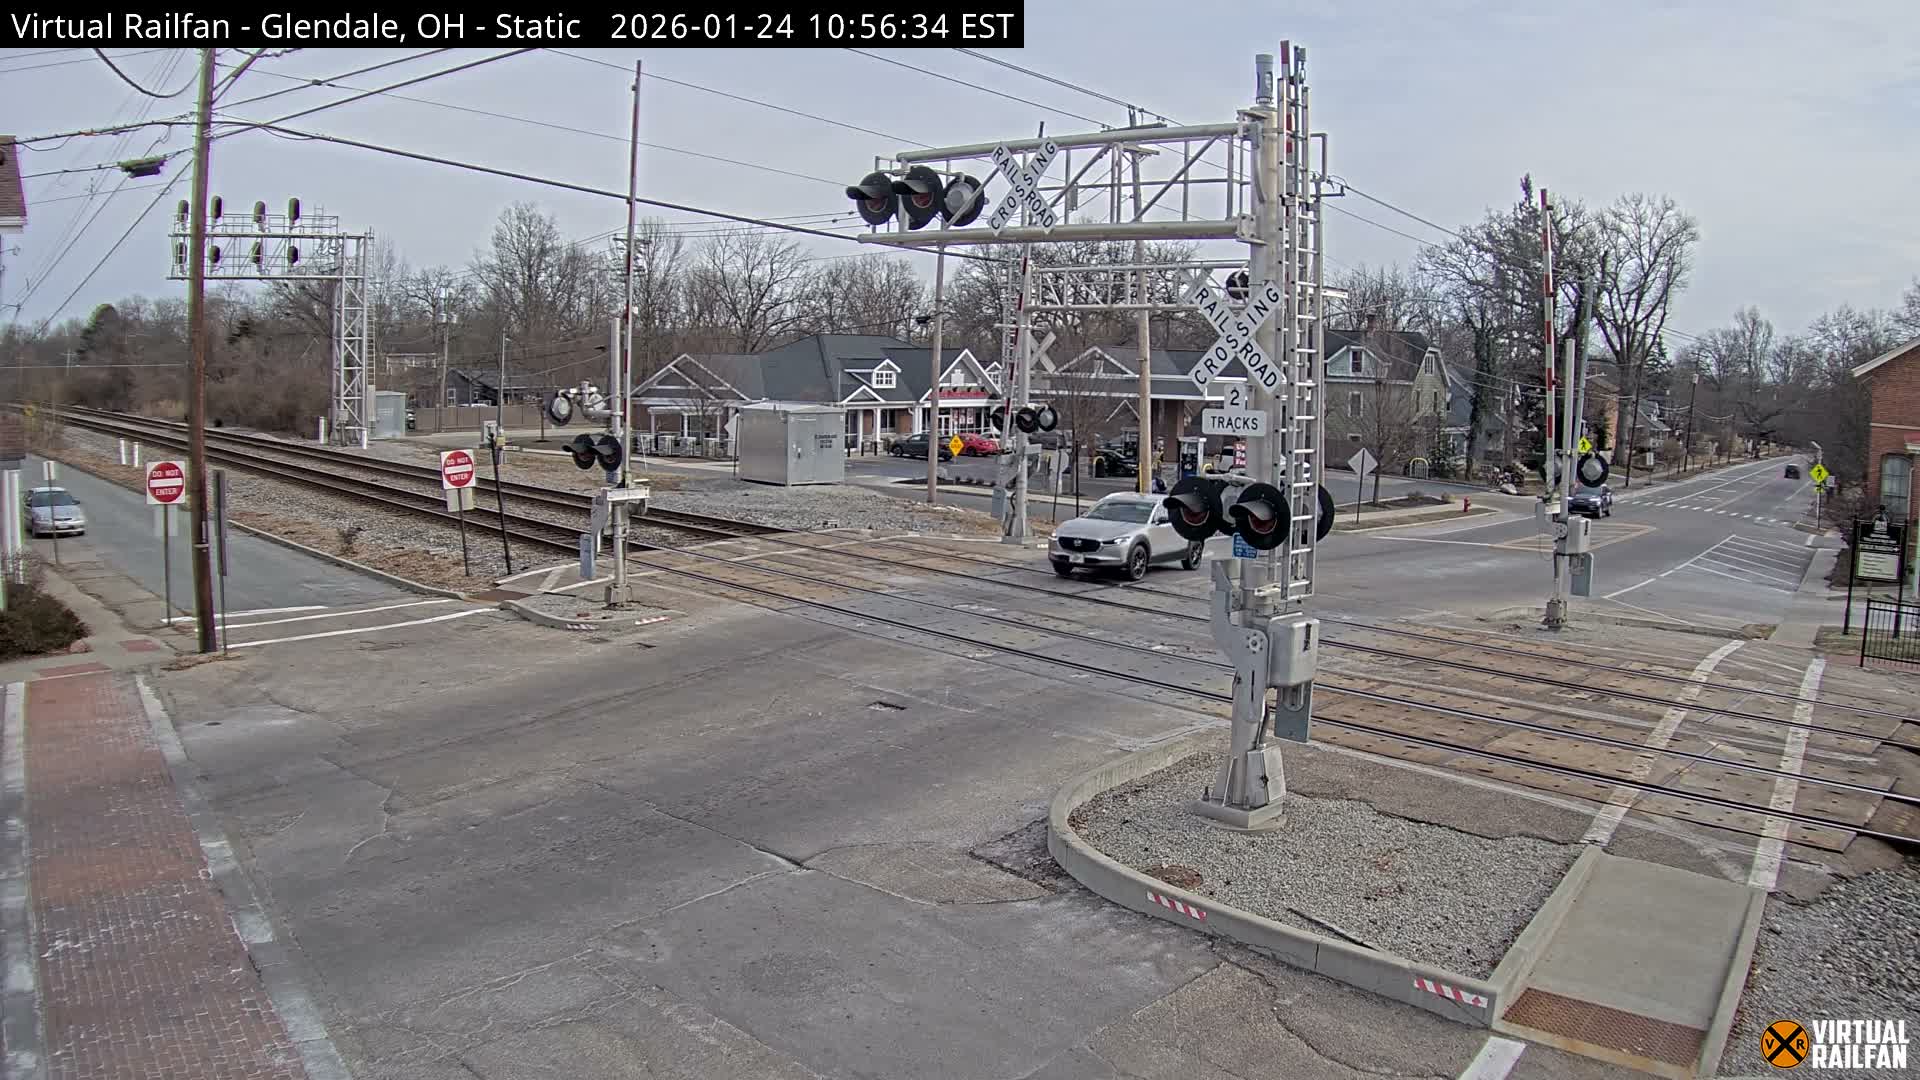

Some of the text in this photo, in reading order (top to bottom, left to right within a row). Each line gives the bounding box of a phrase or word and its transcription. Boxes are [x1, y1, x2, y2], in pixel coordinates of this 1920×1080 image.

[991, 142, 1055, 230] CROSSING
[1194, 288, 1280, 385] CROSSING
[1210, 415, 1259, 431] TRACKS
[1230, 388, 1240, 406] 2
